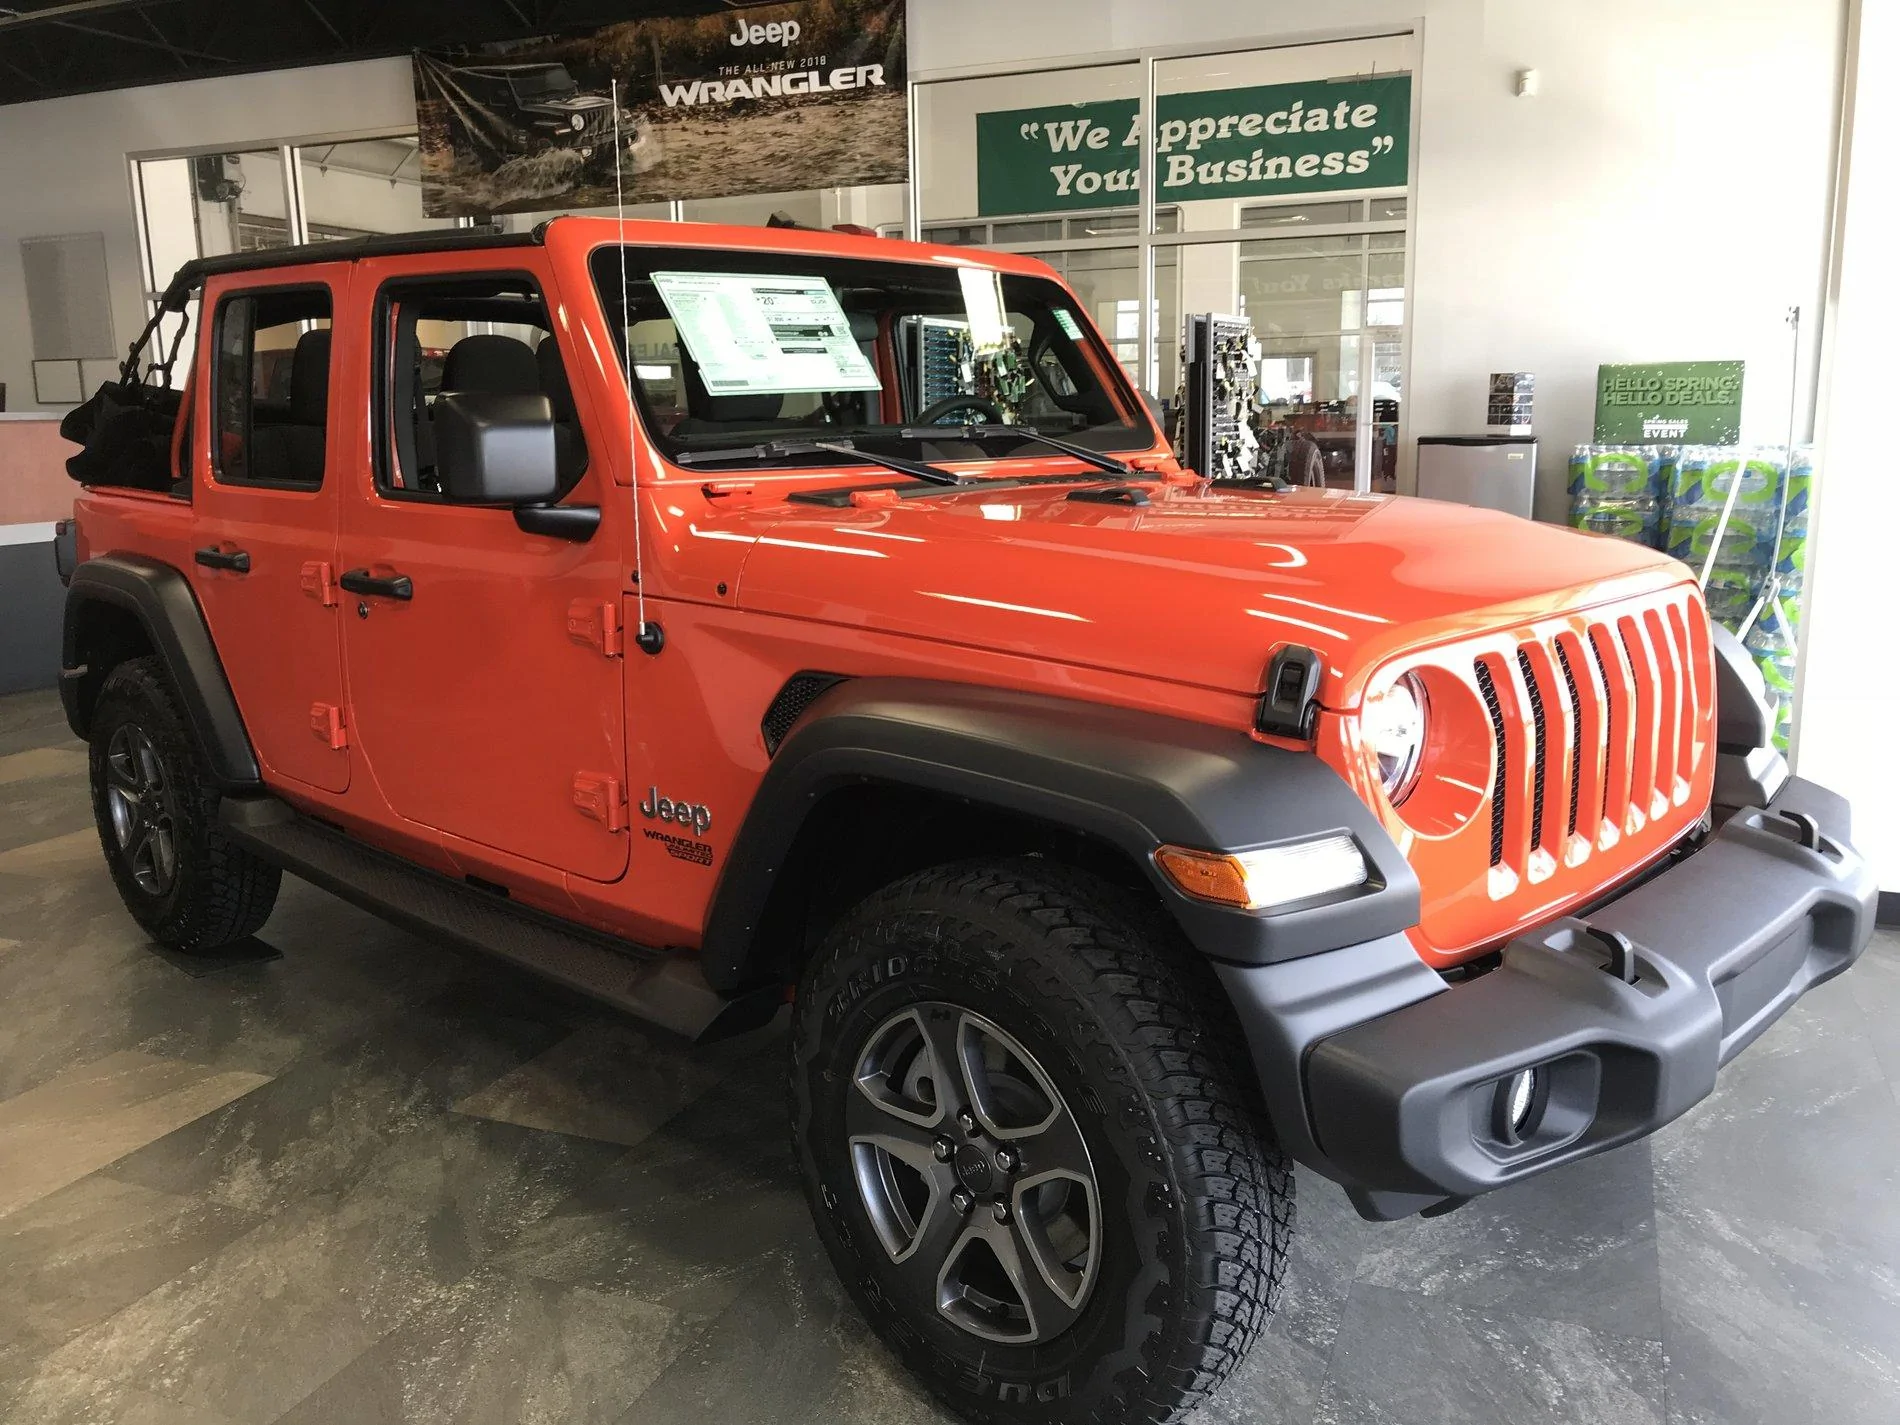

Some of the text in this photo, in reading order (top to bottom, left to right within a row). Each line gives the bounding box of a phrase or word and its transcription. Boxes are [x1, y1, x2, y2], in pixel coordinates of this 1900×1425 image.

[730, 18, 801, 47] Jeep
[719, 55, 827, 76] THE ALL-NEW 2018
[659, 63, 886, 107] WRANGLER
[1122, 100, 1378, 154] Appreciate
[1603, 376, 1739, 392] HELLO SPRING.
[1603, 390, 1735, 406] HELLO DEALS.
[1643, 429, 1687, 439] EVENT
[640, 785, 712, 837] Jeep
[643, 828, 712, 852] WRANGLER
